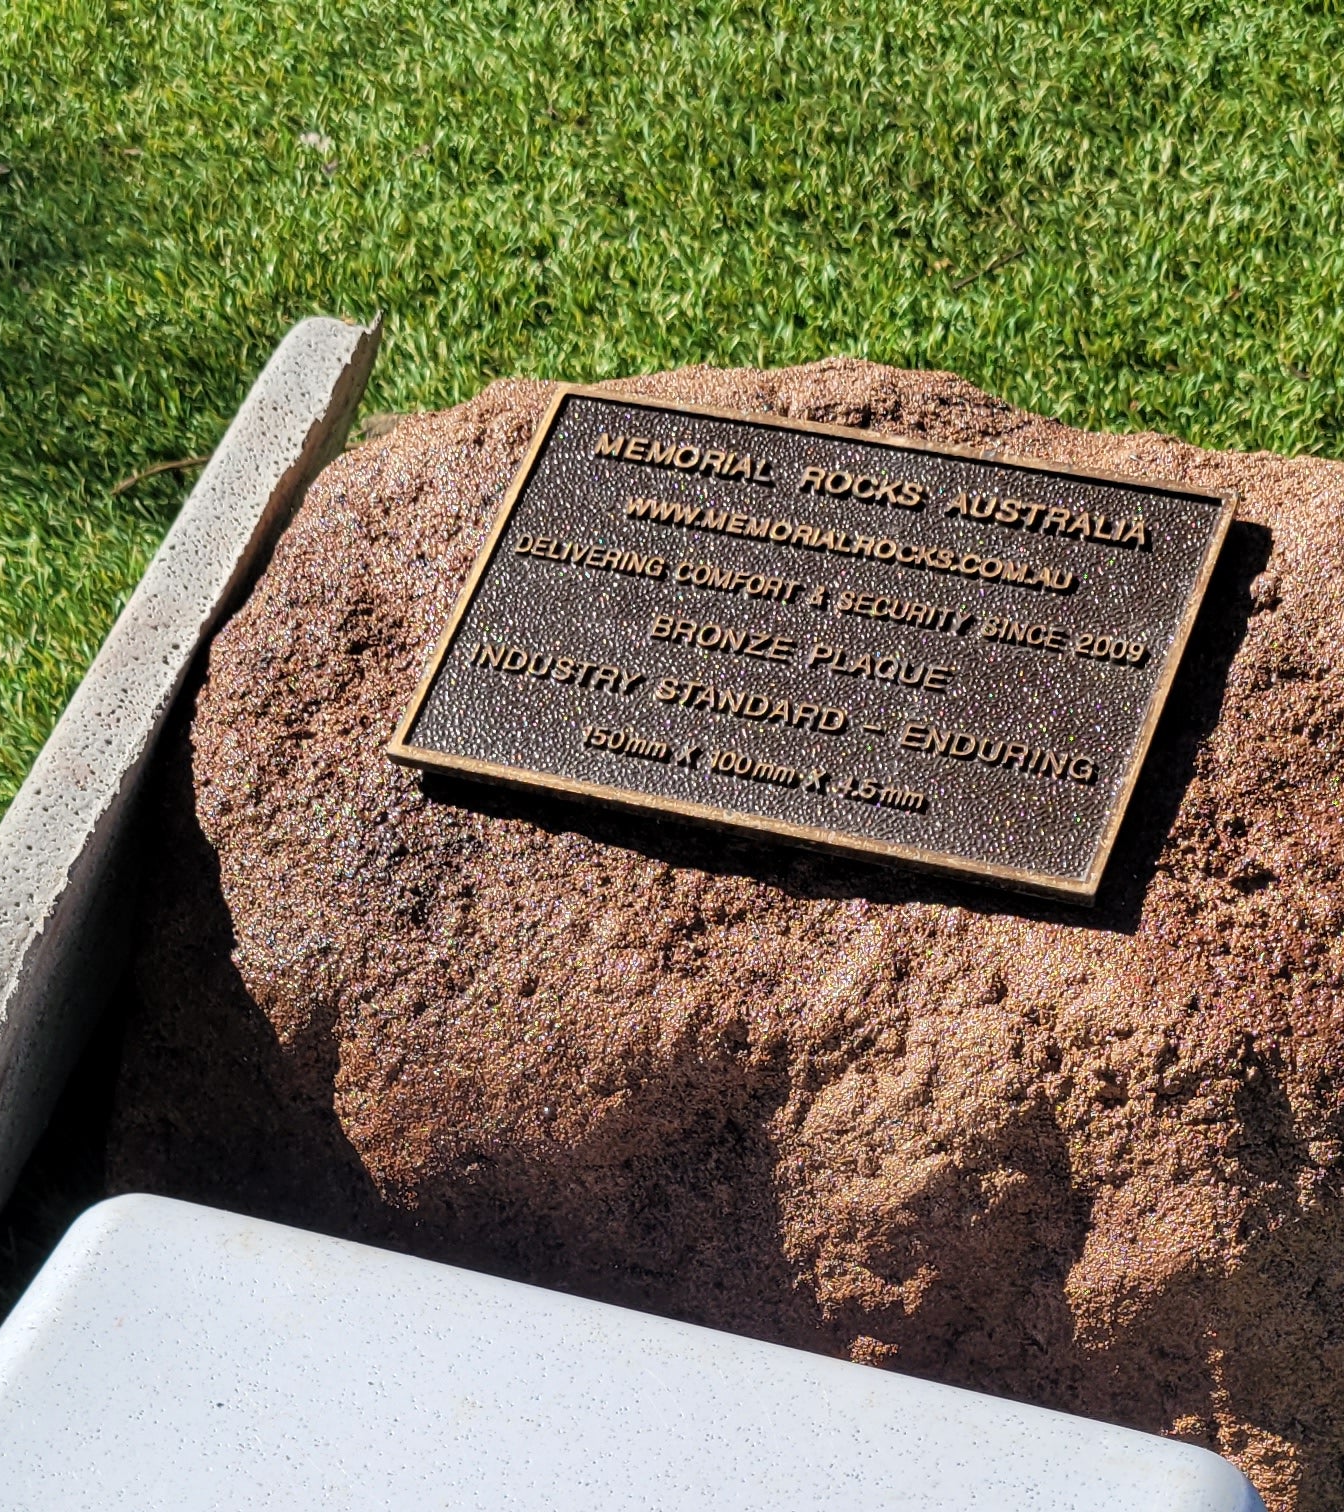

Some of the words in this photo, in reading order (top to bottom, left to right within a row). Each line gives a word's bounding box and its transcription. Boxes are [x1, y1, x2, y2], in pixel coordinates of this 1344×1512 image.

[595, 433, 772, 482] MEMORIAL
[801, 466, 924, 506] ROCKS
[947, 493, 1147, 545] AUSTRALIA
[626, 497, 1074, 590] WWW.MEMORIALROCKS.COM.AU
[514, 532, 666, 577] DELIVERING
[675, 562, 801, 600] COMFORT
[810, 585, 826, 606] &
[837, 590, 973, 633] SECURITY
[981, 616, 1069, 648] SINCE
[1076, 633, 1146, 662] 2009
[651, 615, 794, 660] BRONZE
[808, 643, 950, 690] PLAQUE
[470, 642, 645, 694] INDUSTRY
[656, 677, 846, 732] STANDARD
[901, 722, 1097, 780] ENDURING
[582, 725, 667, 759] 150mm
[710, 749, 796, 785] 100mm
[838, 775, 925, 810] 4.5mm
